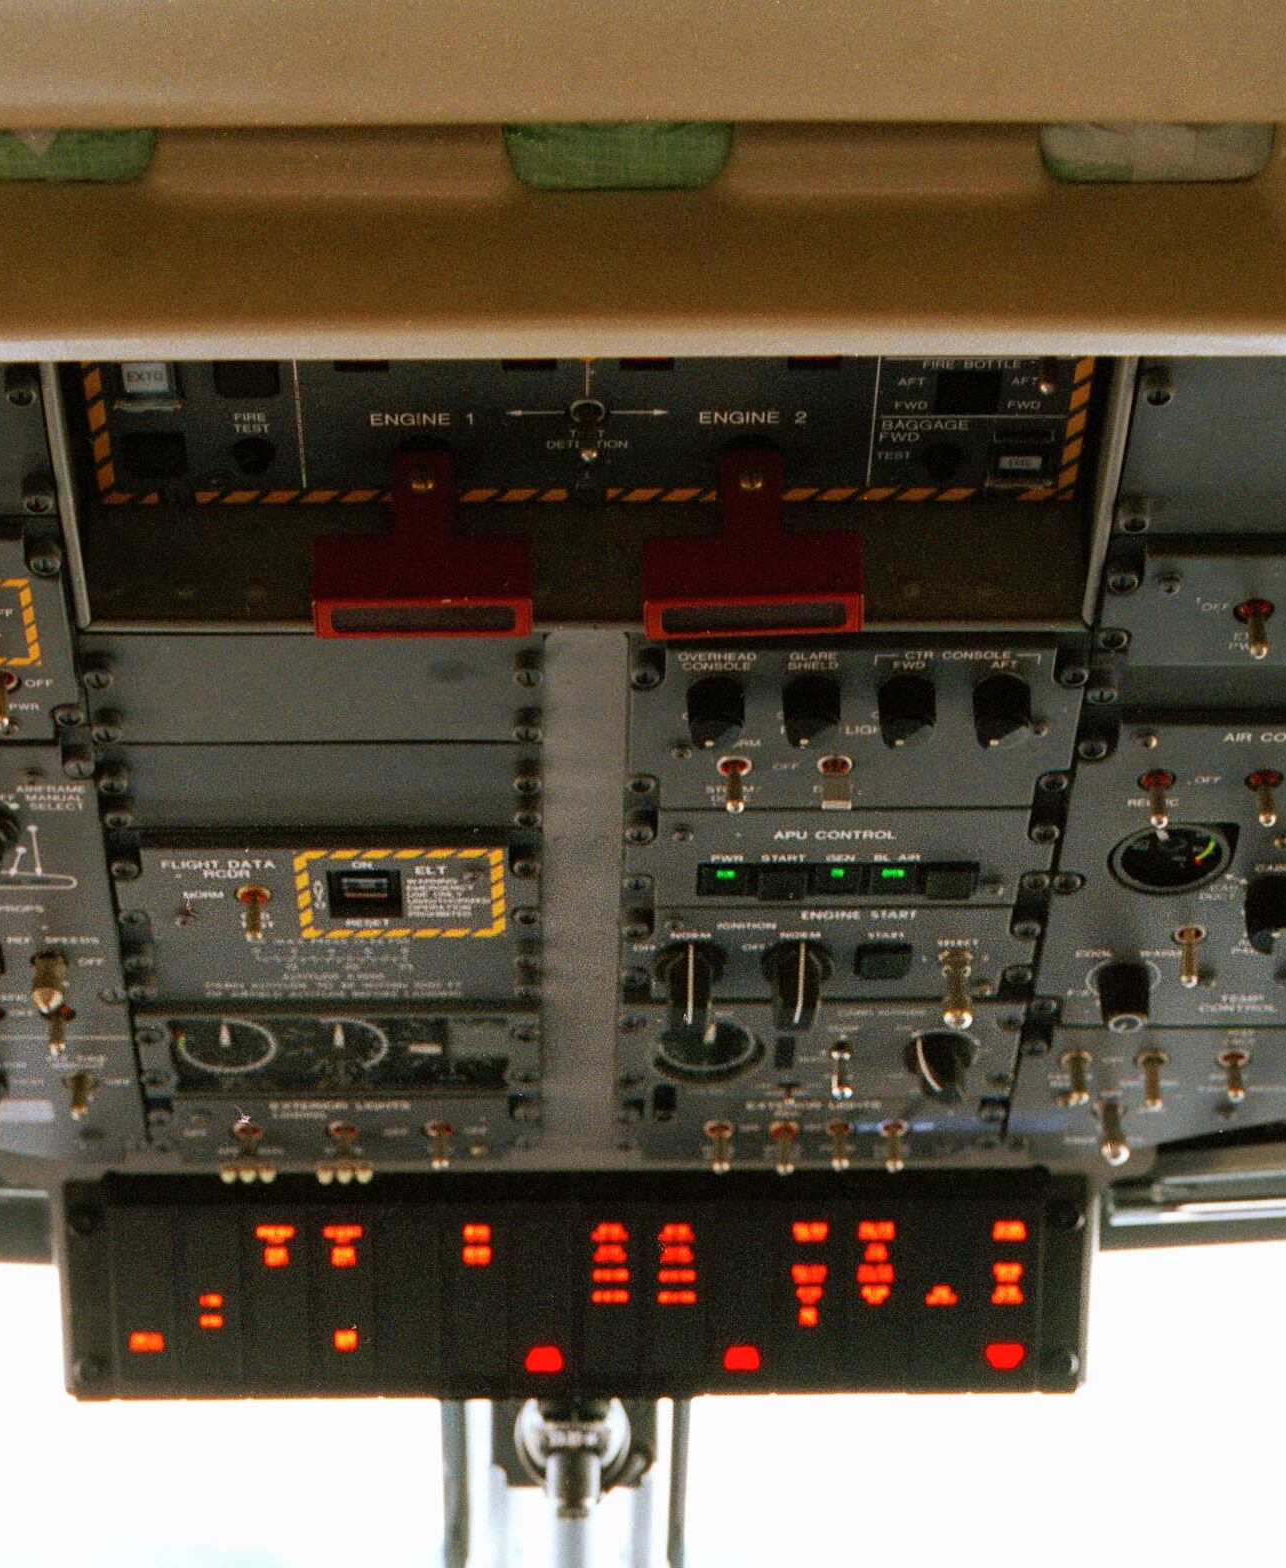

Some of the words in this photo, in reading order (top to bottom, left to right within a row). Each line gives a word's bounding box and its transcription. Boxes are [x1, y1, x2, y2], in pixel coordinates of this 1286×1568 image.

[897, 377, 926, 387] AFT
[895, 402, 929, 411] FWD
[1007, 402, 1042, 411] FWD
[233, 412, 266, 422] FIRE
[369, 412, 452, 427] ENGINE
[465, 412, 475, 426] 1
[698, 411, 781, 425] ENGINE
[795, 410, 808, 424] 2
[233, 423, 271, 434] TEST
[881, 420, 969, 432] BAGGAGE
[879, 432, 921, 443] FWD
[1201, 602, 1230, 612] OFF
[677, 651, 758, 662] OVERHEAD
[789, 651, 839, 661] GLARE
[904, 651, 934, 661] CTR
[942, 651, 1012, 661] CONSOLE
[682, 662, 752, 672] CONSOLE
[787, 662, 840, 671] SHIELD
[892, 661, 927, 671] FWD
[991, 661, 1018, 671] AFT
[24, 678, 54, 689] OFF
[1223, 732, 1253, 743] AIR
[773, 830, 808, 840] APU
[814, 830, 897, 840] CONTROL
[710, 853, 745, 863] PWR
[761, 853, 807, 863] START
[825, 853, 857, 863] GEN
[161, 860, 219, 871] FLIGHT
[226, 860, 276, 870] DATA
[414, 866, 447, 876] ELT
[182, 891, 225, 900] NORM
[800, 910, 861, 921] ENGINE
[871, 910, 917, 920] START
